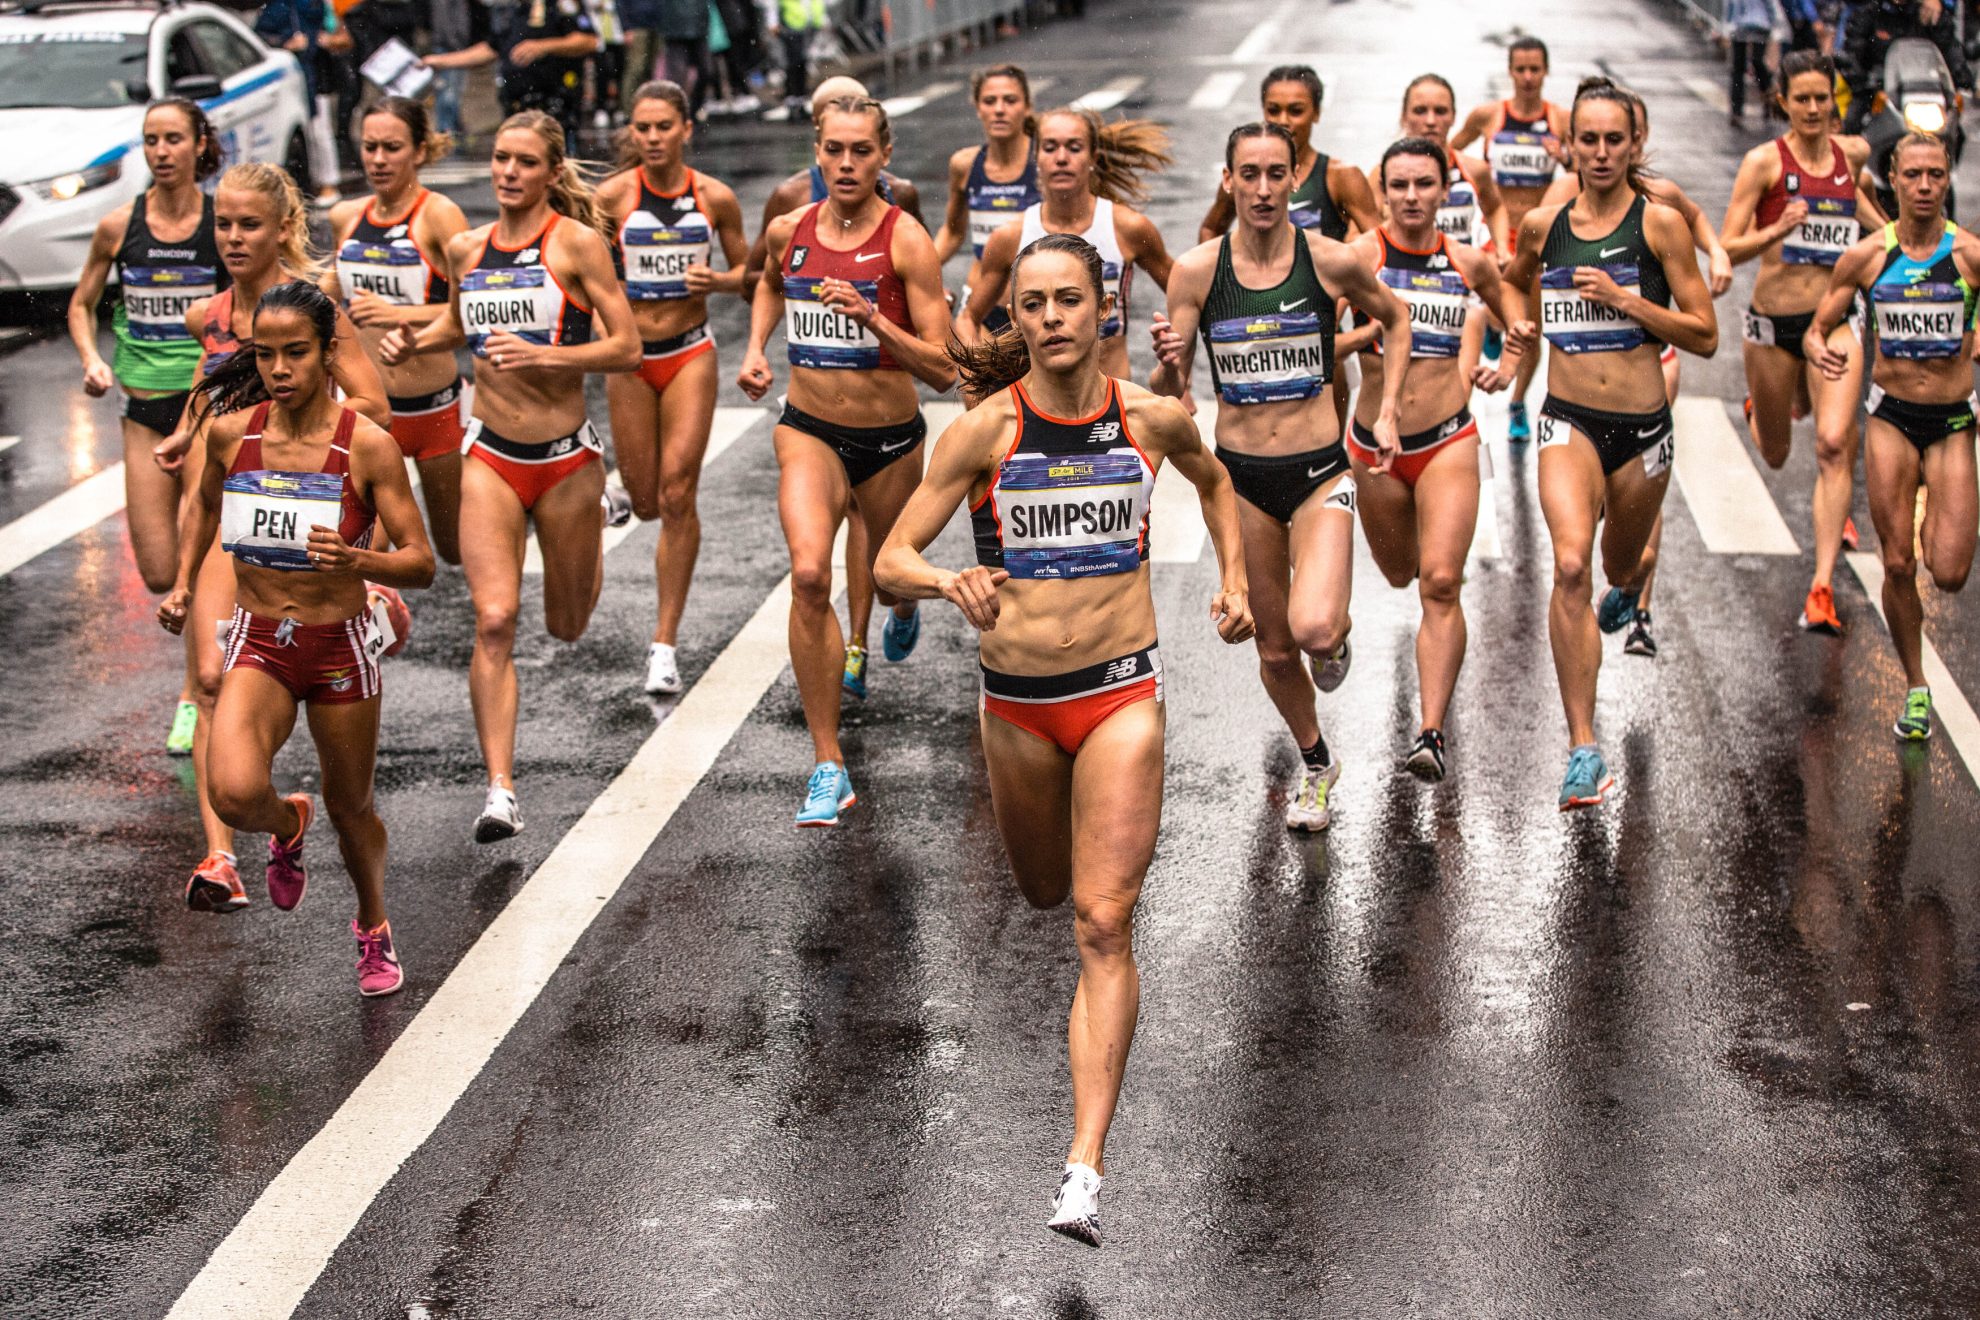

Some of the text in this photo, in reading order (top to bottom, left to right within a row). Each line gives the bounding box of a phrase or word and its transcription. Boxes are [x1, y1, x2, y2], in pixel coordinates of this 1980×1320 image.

[1802, 224, 1851, 246] GRACE
[640, 253, 696, 275] MCGEE
[352, 273, 406, 297] TWELL
[126, 294, 213, 317] SIFUENT
[467, 299, 536, 326] COBURN
[794, 310, 865, 340] QUIGLEY
[1885, 311, 1955, 334] MACKEY
[1216, 345, 1320, 374] WEIGHTMAN
[1074, 466, 1094, 474] MILE
[253, 508, 297, 540] PEN
[1010, 498, 1133, 539] SIMPSON
[1070, 562, 1119, 573] #NB5thAveMile
